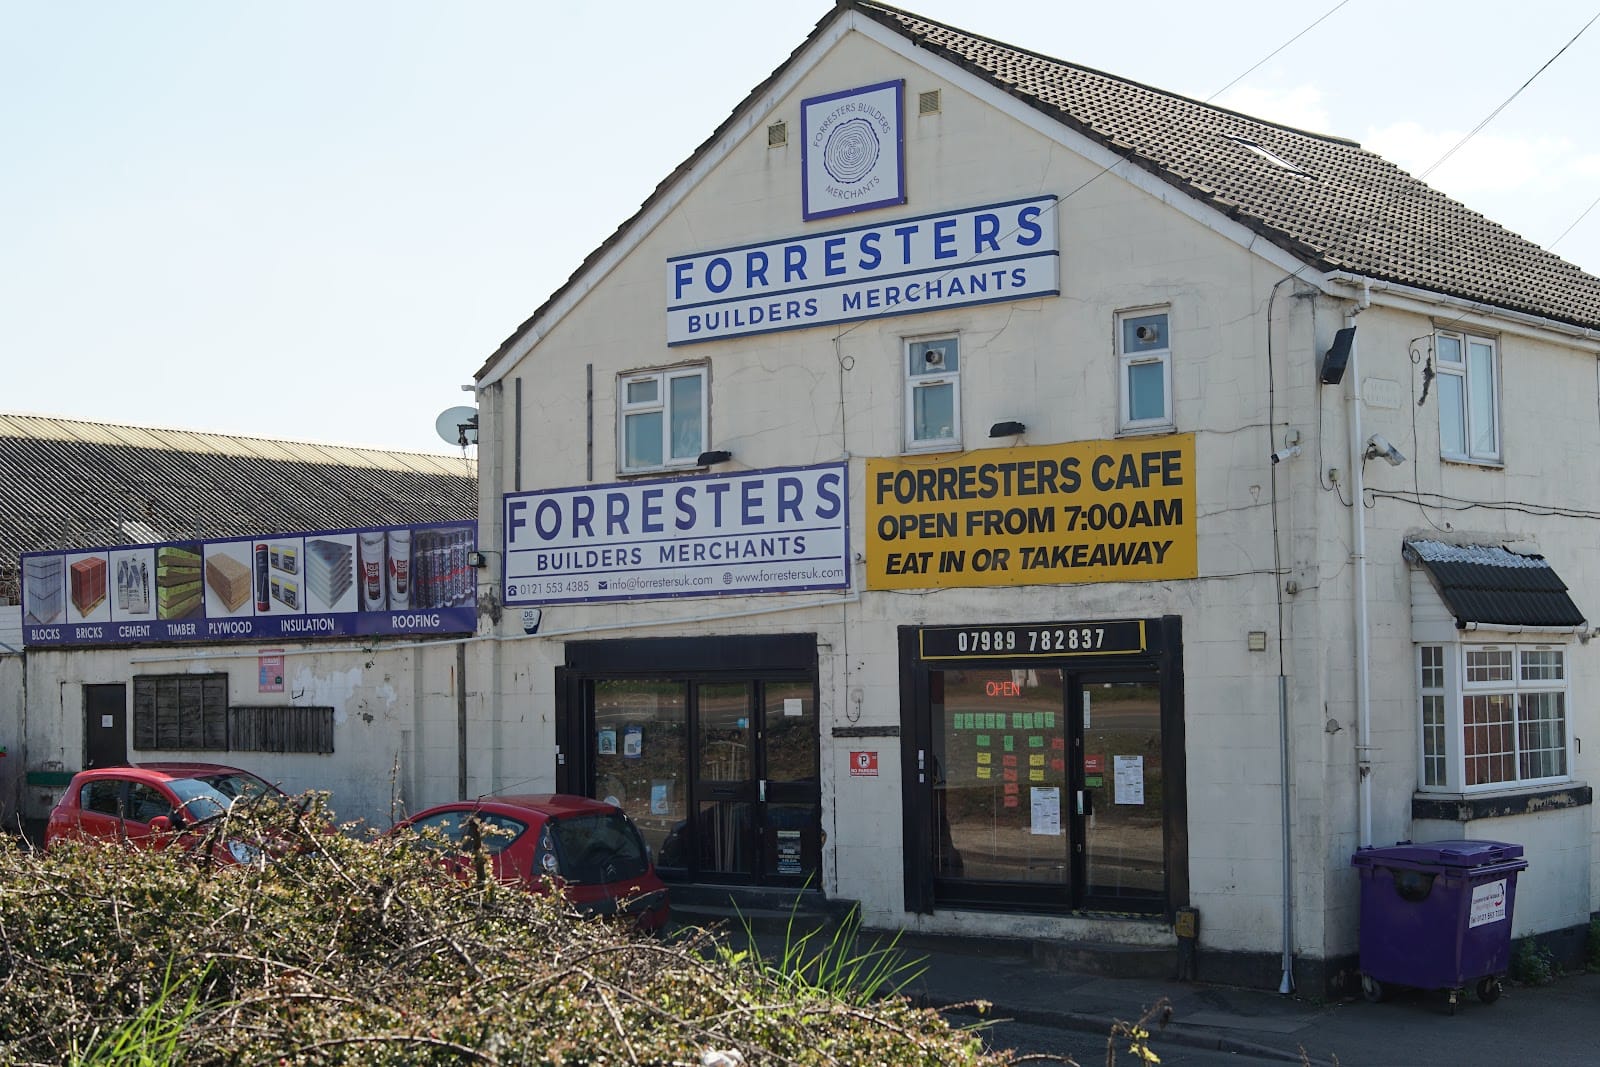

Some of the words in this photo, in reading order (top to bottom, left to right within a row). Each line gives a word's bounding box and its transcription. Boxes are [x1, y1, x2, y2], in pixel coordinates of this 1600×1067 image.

[814, 102, 856, 148] FORRESTERS
[858, 102, 891, 135] BUILDERS
[825, 176, 880, 200] MERCHANTS
[675, 206, 1042, 300] FORRESTERS
[688, 298, 818, 333] BUILDERS
[842, 268, 1026, 312] MERCHANTS
[877, 457, 1082, 504] FORRESTERS
[1091, 450, 1183, 491] CAFE
[508, 473, 842, 543] FORRESTERS
[878, 512, 957, 541] OPEN
[966, 507, 1055, 536] FROM
[1064, 498, 1183, 531] 7:00AM
[537, 548, 642, 571] BUILDERS
[659, 536, 806, 563] MERCHANTS
[886, 552, 933, 575] EAT
[939, 550, 966, 573] IN
[972, 549, 1010, 572] OR
[1019, 541, 1173, 570] TAKEAWAY
[610, 575, 713, 590] info@forrestersuk.com
[735, 567, 844, 583] www.forrestersuk.com
[520, 583, 542, 595] 0121
[546, 582, 563, 594] 553
[566, 581, 589, 593] 4385
[167, 623, 196, 635] TIMBER
[208, 621, 252, 634] PLYWOOD
[281, 618, 335, 632] INSULATION
[392, 613, 441, 629] ROOFING
[31, 628, 60, 640] BLOCKS
[76, 627, 103, 639] BRICKS
[119, 625, 150, 637] CEMENT
[958, 630, 1016, 651] 07989
[1028, 628, 1105, 651] 782837
[986, 681, 1020, 697] OPEN
